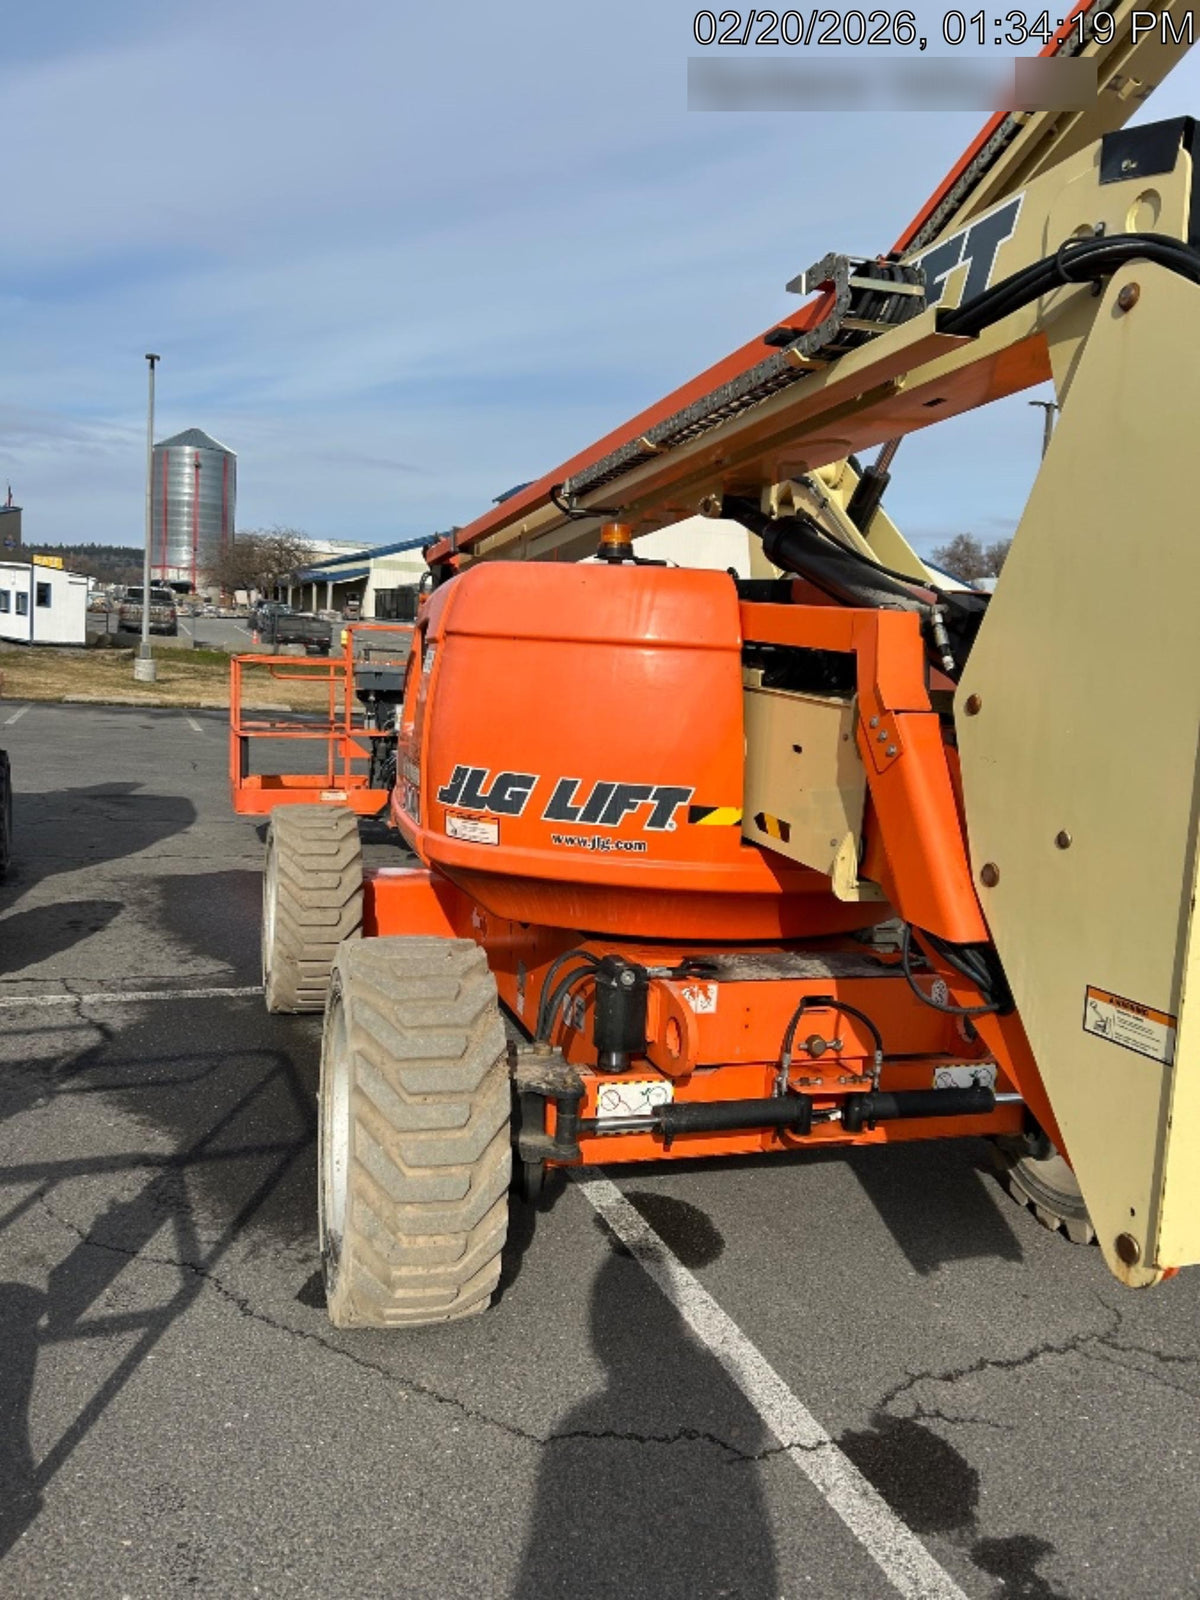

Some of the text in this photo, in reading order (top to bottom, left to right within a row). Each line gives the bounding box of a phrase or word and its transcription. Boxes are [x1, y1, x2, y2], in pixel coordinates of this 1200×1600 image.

[909, 190, 1026, 310] FT
[437, 765, 540, 817] JLG
[541, 777, 696, 831] LIFT
[551, 833, 648, 852] www.jlg.com
